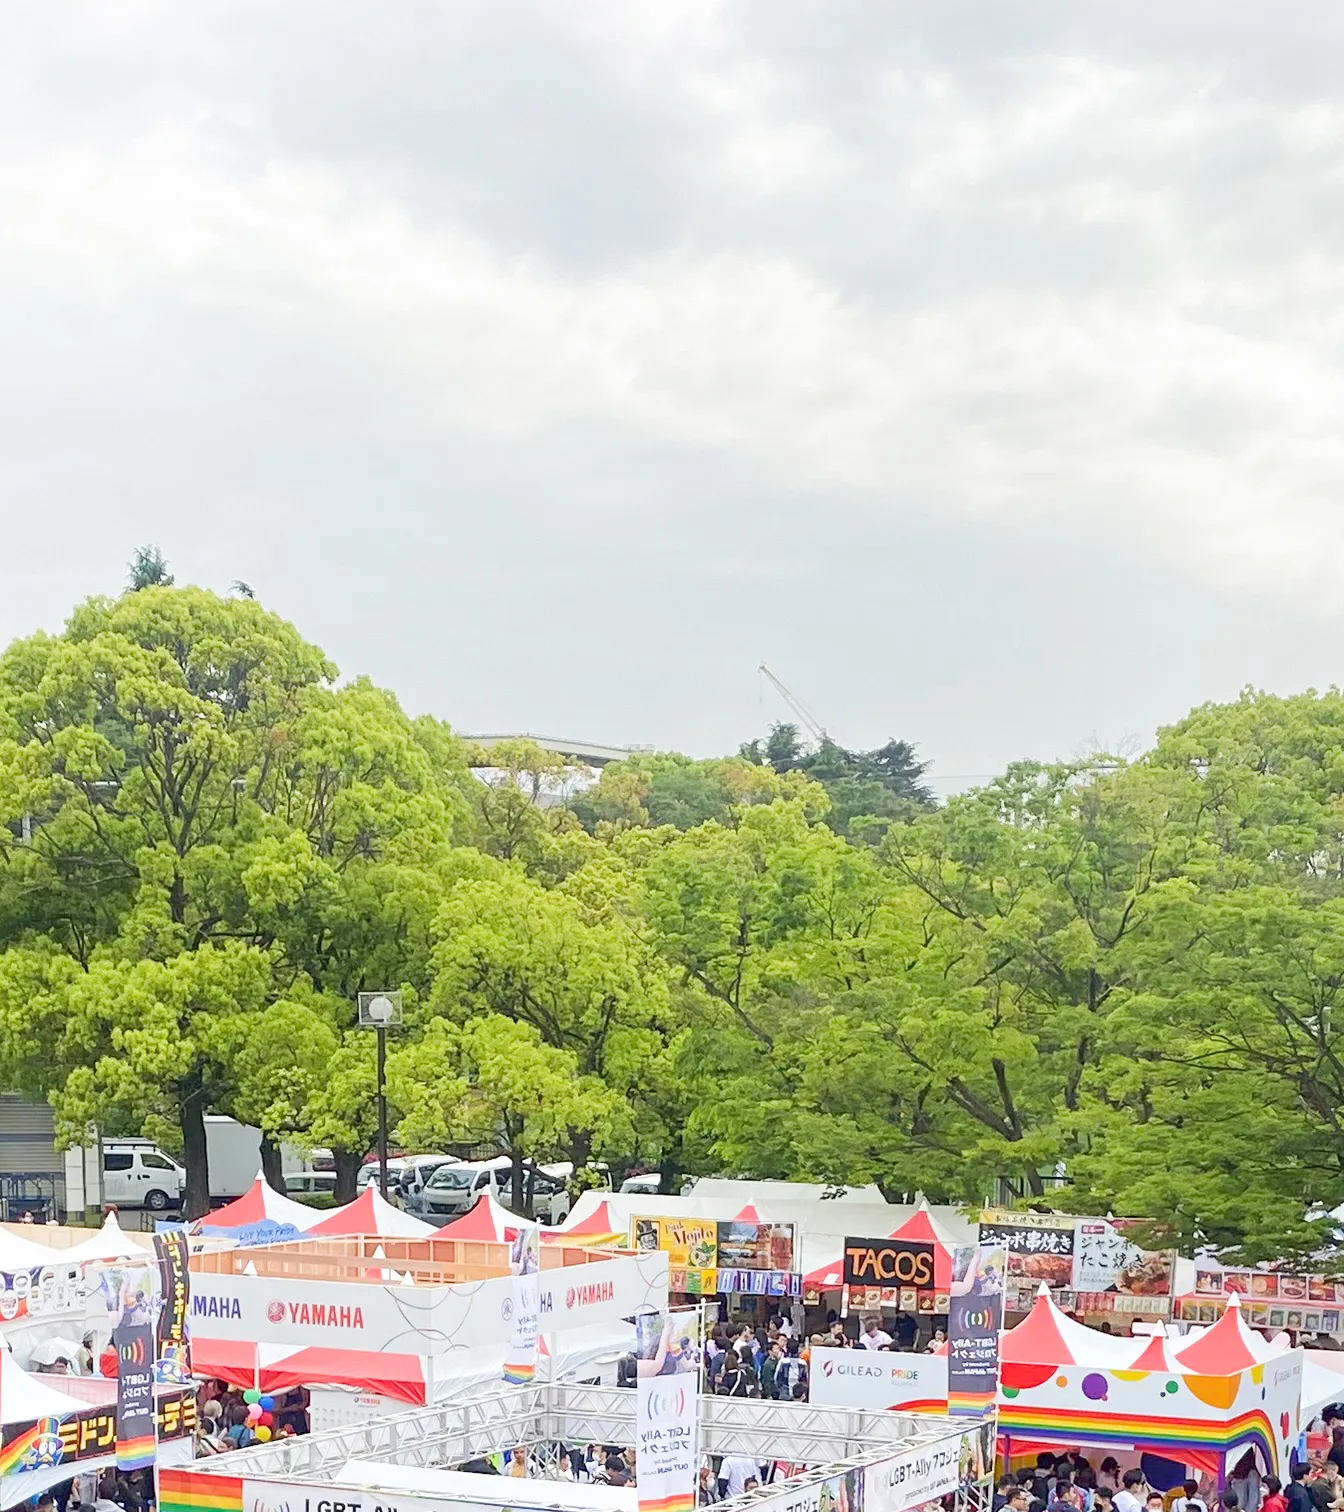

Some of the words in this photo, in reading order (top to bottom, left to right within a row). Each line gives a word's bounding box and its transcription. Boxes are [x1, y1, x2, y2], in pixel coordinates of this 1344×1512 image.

[846, 1247, 934, 1286] TACOS
[190, 1296, 242, 1320] MAHA
[575, 1281, 615, 1308] YAMAHA
[287, 1302, 365, 1330] YAMAHA
[837, 1364, 883, 1378] GILEAD
[890, 1367, 920, 1381] PRIDE
[889, 1459, 932, 1487] LGBT-Ally
